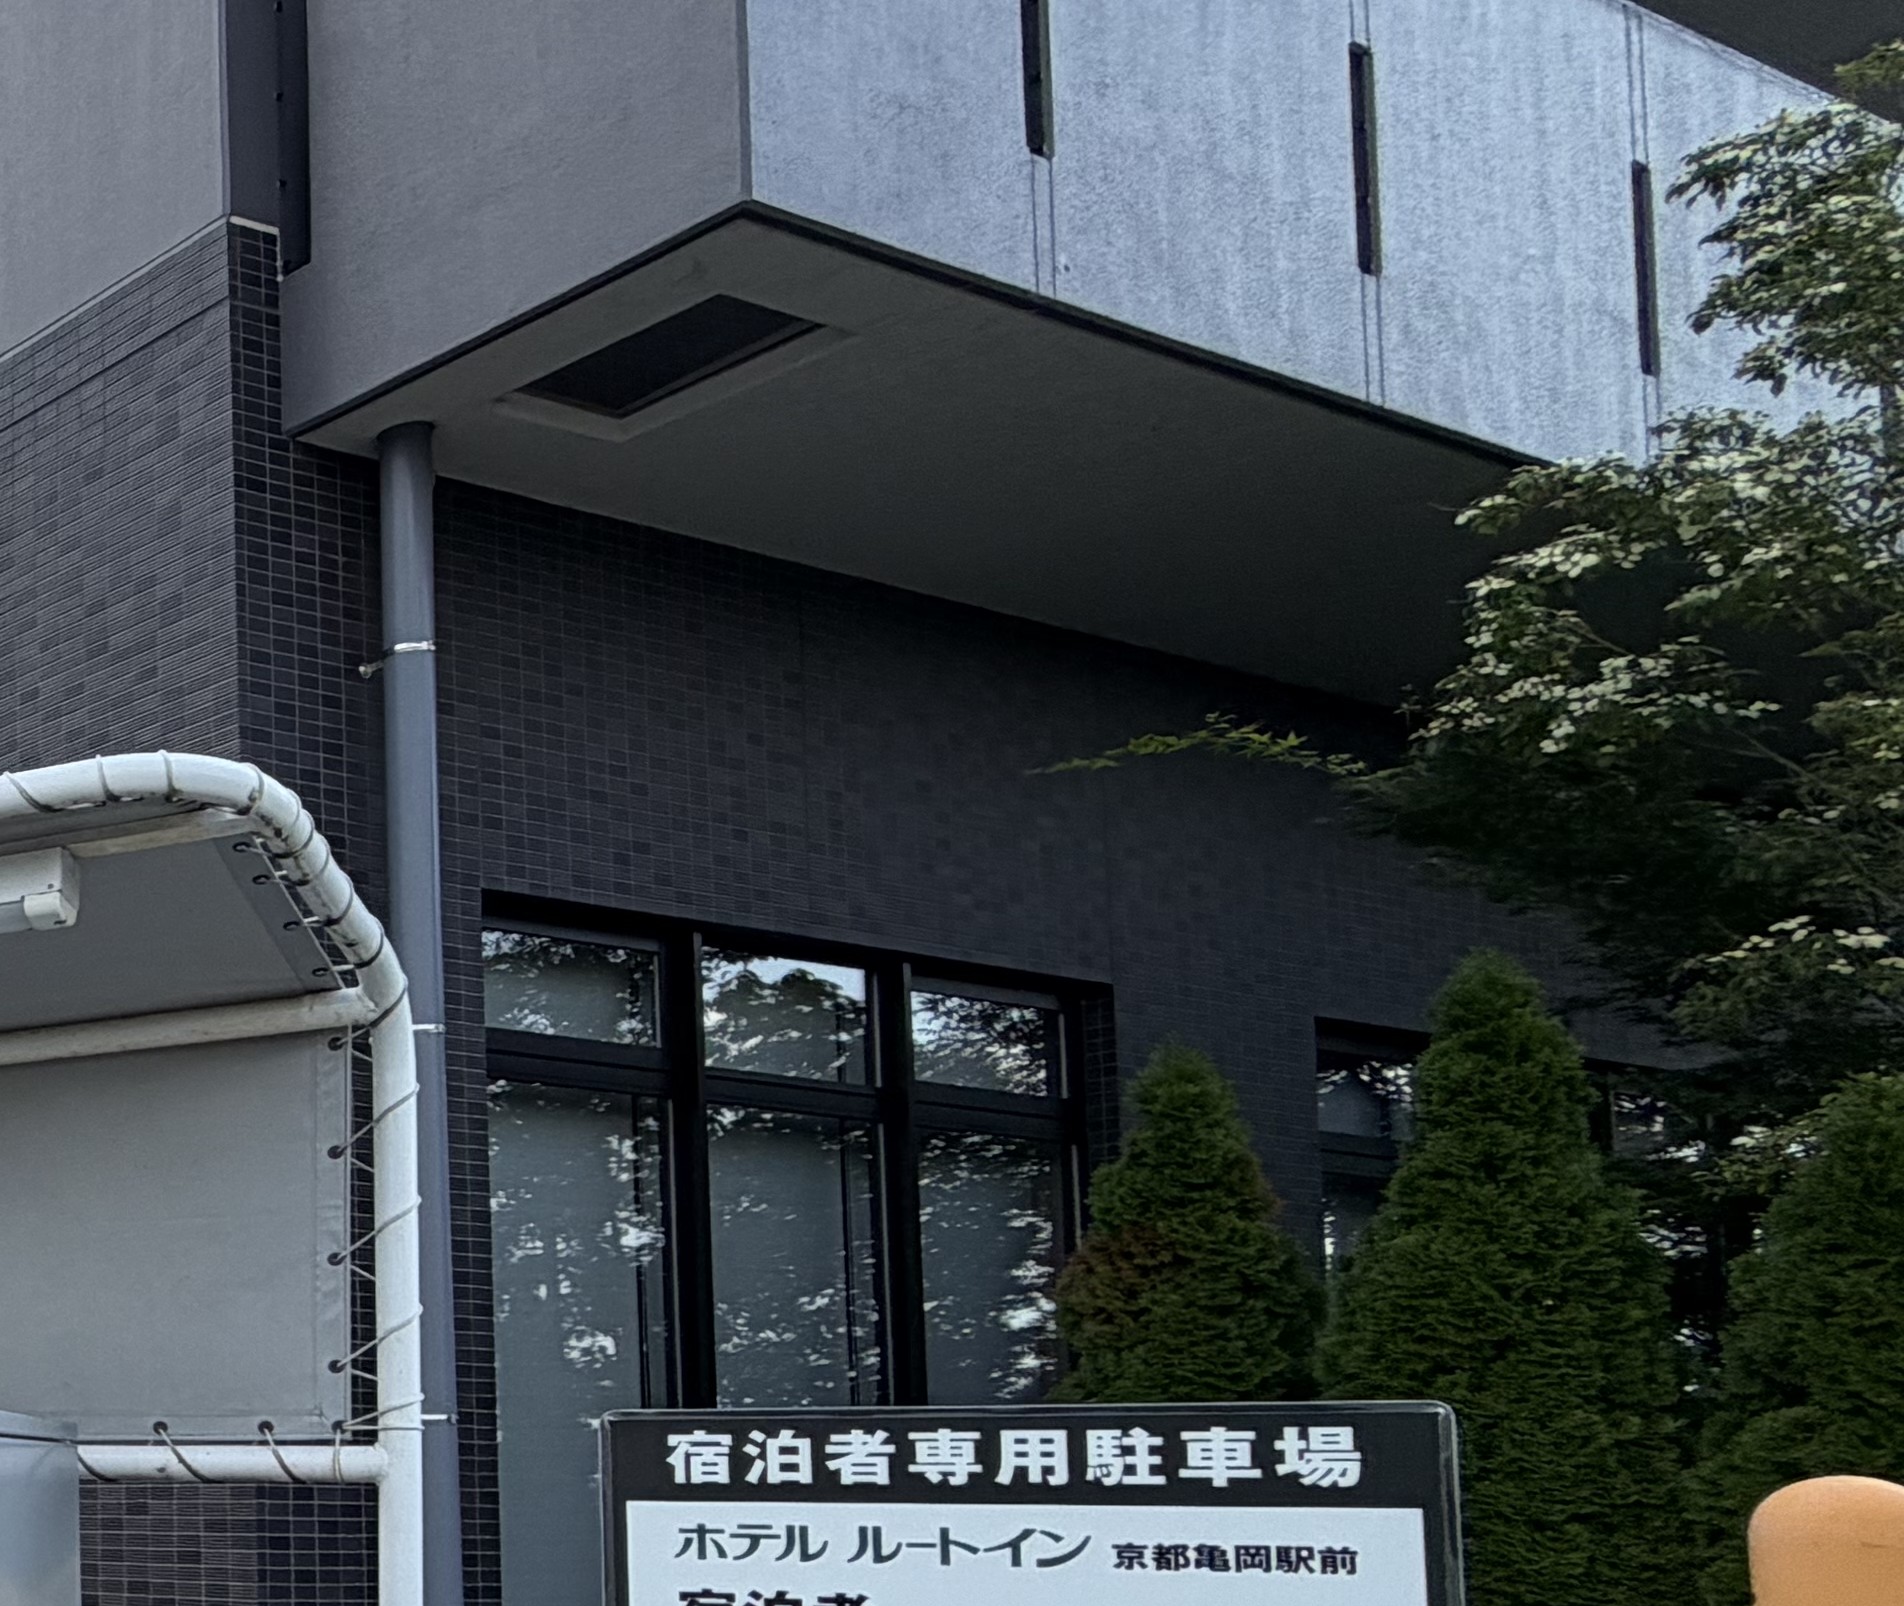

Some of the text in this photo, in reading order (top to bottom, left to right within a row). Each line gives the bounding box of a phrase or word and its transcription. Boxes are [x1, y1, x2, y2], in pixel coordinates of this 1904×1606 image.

[666, 1426, 1364, 1489] 宿泊者専用駐車場
[674, 1524, 1359, 1577] ホテル ルートイン 京都亀岡駅前
